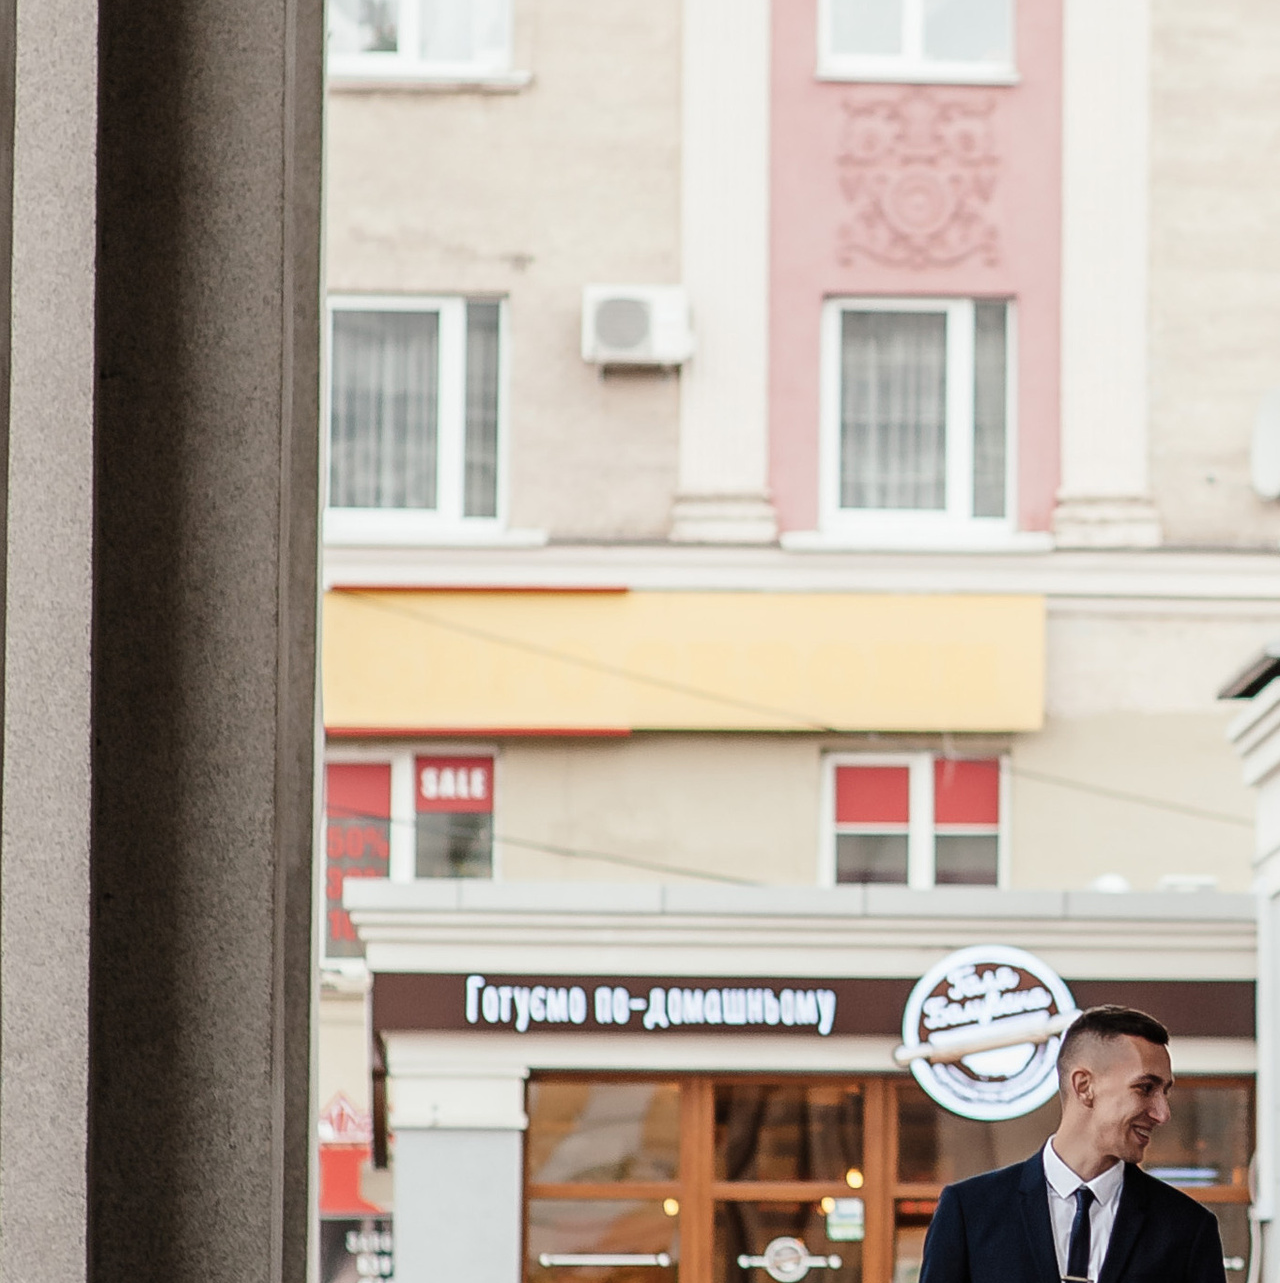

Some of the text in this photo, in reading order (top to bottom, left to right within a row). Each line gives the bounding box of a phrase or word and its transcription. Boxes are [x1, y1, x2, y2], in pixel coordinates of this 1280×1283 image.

[420, 767, 487, 800] SALE
[466, 974, 837, 1036] Готуємо по-домашньому
